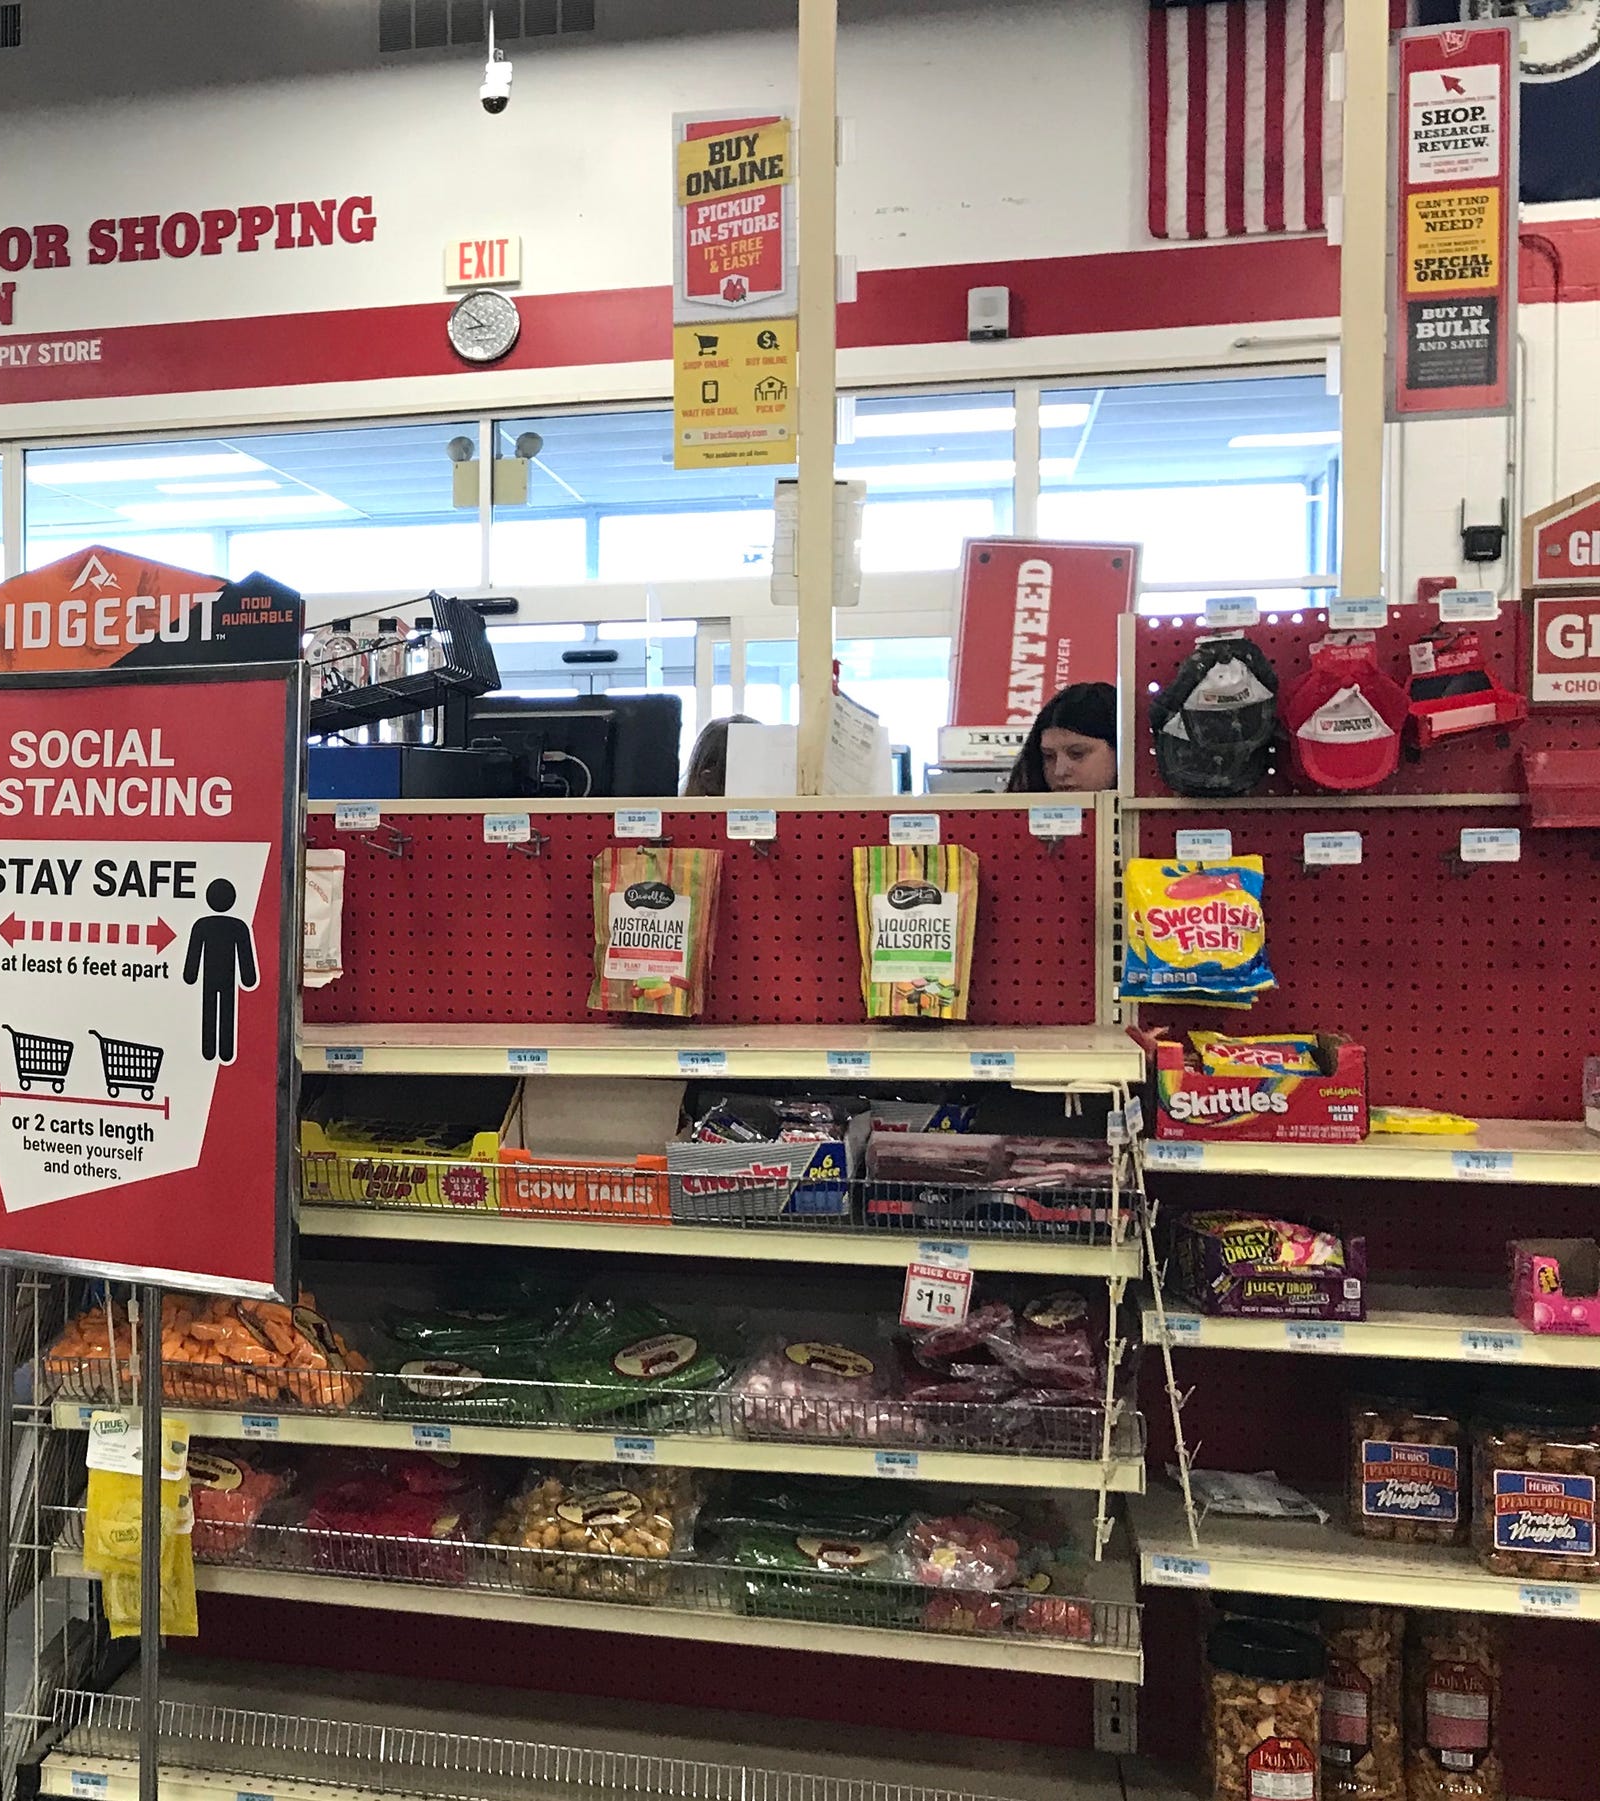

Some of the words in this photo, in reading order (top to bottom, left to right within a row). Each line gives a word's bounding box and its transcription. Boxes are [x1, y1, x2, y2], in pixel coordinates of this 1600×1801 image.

[1421, 106, 1487, 126] SHOP.
[1413, 124, 1495, 140] RESEARCH.
[708, 132, 759, 167] BUY
[1417, 137, 1490, 153] REVIEW.
[686, 154, 784, 197] ONLINE
[697, 194, 766, 225] PICKUP
[1415, 198, 1454, 210] CAN'T
[1457, 195, 1490, 206] FIND
[1418, 209, 1456, 220] WHAT
[1460, 206, 1485, 217] YOU
[87, 195, 378, 266] SHOPPING
[690, 211, 779, 247] IN-STORE
[1424, 217, 1483, 233] NEED?
[703, 244, 728, 261] IT'S
[731, 236, 764, 256] FREE
[458, 239, 508, 281] EXIT
[709, 260, 719, 274] &
[722, 251, 762, 271] EASY!
[1414, 254, 1492, 270] SPECIAL
[1416, 267, 1490, 282] ORDER!
[1421, 306, 1459, 321] BUY
[1462, 305, 1483, 317] IN
[1415, 318, 1490, 339] BULK
[37, 340, 102, 364] STORE
[1417, 341, 1448, 352] AND
[1450, 338, 1488, 350] SAVE!
[704, 359, 730, 369] ONLINE
[762, 356, 788, 365] ONLINE
[681, 408, 699, 418] WAIT
[701, 407, 716, 417] FOR
[717, 406, 739, 416] EMAIL
[756, 404, 773, 414] PICK
[774, 403, 786, 412] UP
[240, 596, 272, 610] NOW
[221, 609, 293, 626] AVAILABLE
[9, 728, 175, 768] SOCIAL
[92, 859, 197, 899] SAFE
[612, 917, 684, 934] AUSTRALIAN
[878, 918, 951, 933] LIQUORICE
[1146, 901, 1259, 940] Swedish
[611, 931, 682, 950] LIQUORICE
[876, 933, 951, 950] ALLSORTS
[1175, 925, 1243, 953] Fish
[1, 955, 18, 972] at
[22, 955, 62, 975] least
[67, 957, 78, 975] 6
[82, 956, 118, 977] feet
[121, 960, 169, 982] apart
[517, 1054, 541, 1062] $1.99
[1169, 1086, 1289, 1120] Skittles
[12, 1117, 30, 1131] or
[34, 1113, 45, 1132] 2
[50, 1116, 94, 1136] carts
[99, 1117, 154, 1144] length
[940, 1116, 951, 1129] 6
[23, 1136, 82, 1156] between
[86, 1143, 143, 1162] yourself
[44, 1159, 70, 1175] and
[73, 1161, 122, 1181] others.
[822, 1154, 833, 1168] 6
[352, 1161, 428, 1184] MALLO
[681, 1163, 791, 1195] Chunky
[809, 1166, 840, 1178] Piece
[365, 1181, 412, 1199] CUP
[517, 1178, 576, 1200] COW
[587, 1182, 654, 1204] TALES
[1224, 1245, 1265, 1263] DROP
[912, 1264, 944, 1279] PRICE
[946, 1271, 968, 1282] CUT
[1245, 1280, 1285, 1297] JUICY
[1286, 1282, 1314, 1294] DROP
[99, 1418, 124, 1429] TRUE
[1369, 1465, 1412, 1480] PEANUT
[1385, 1478, 1433, 1494] Pretzel
[1376, 1488, 1441, 1510] Nuggets
[1502, 1495, 1543, 1510] PEANUT
[1545, 1499, 1588, 1514] BUTTER
[1519, 1510, 1569, 1527] Pretzel
[1508, 1522, 1577, 1543] Nuggets
[1259, 1751, 1285, 1768] Pub
[1286, 1754, 1310, 1768] Mix
